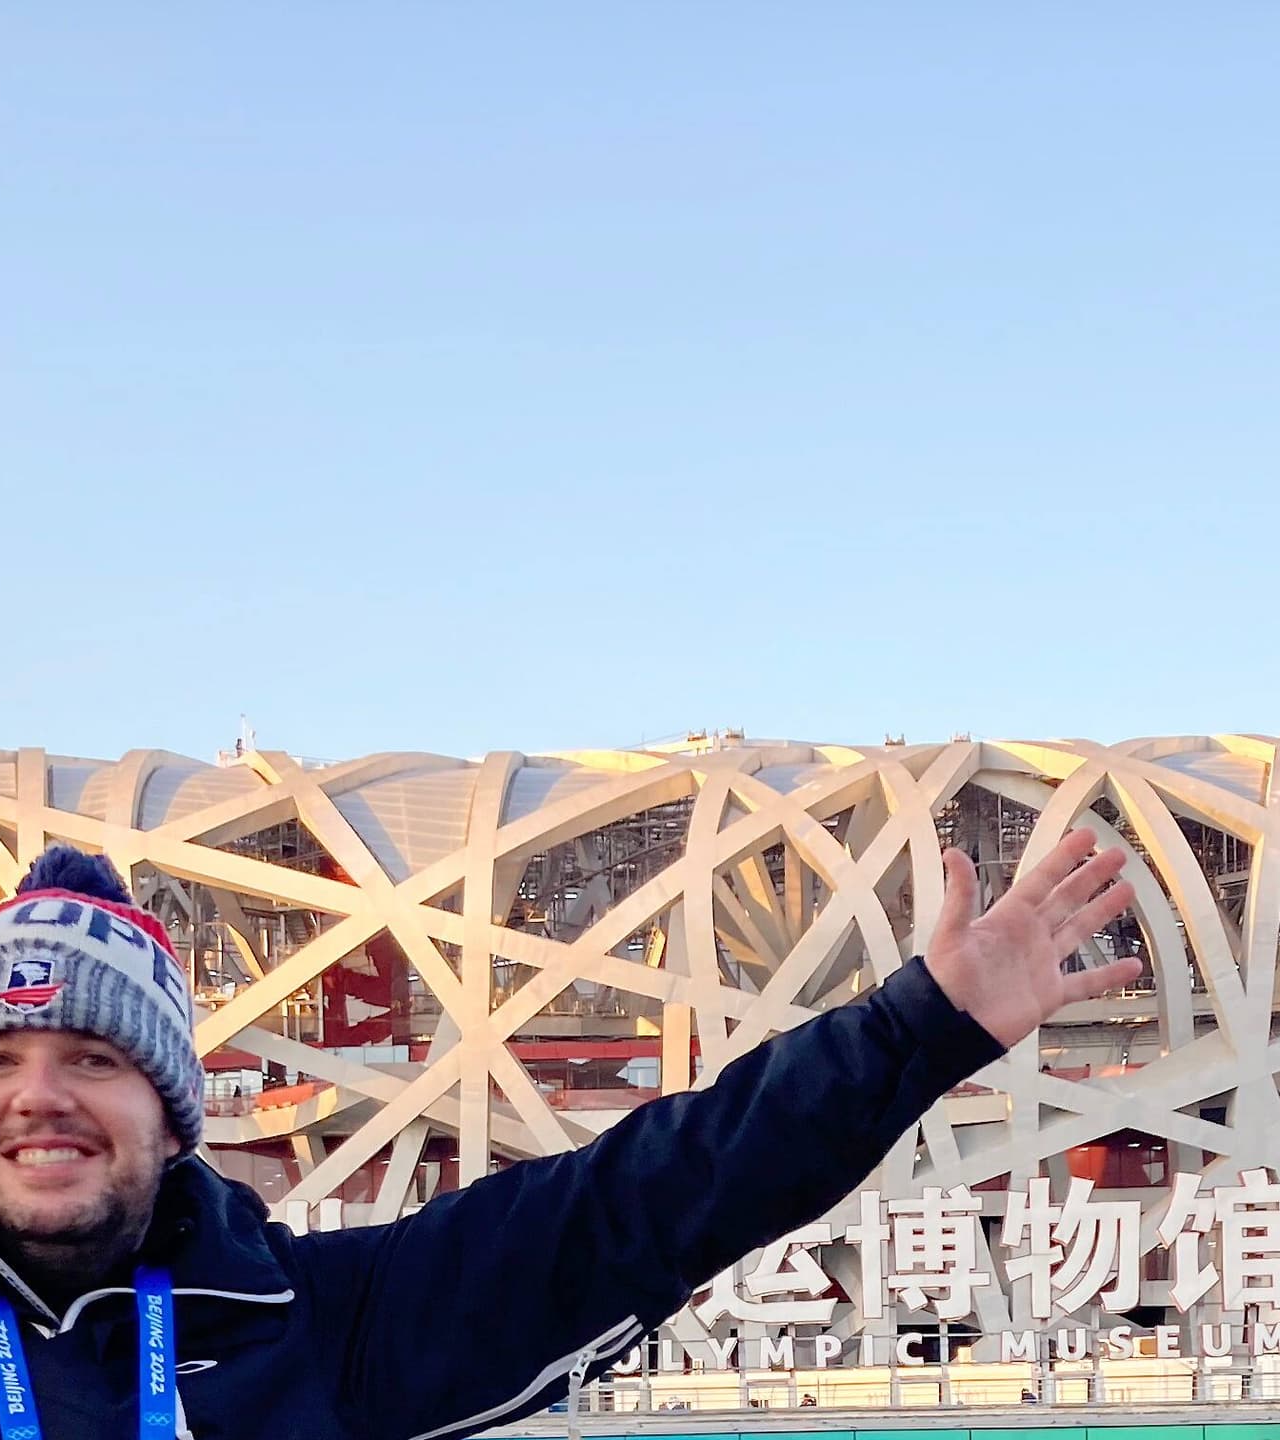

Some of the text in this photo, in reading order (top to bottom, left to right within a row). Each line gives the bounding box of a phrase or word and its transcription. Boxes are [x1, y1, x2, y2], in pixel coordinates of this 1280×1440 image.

[146, 1294, 166, 1396] BEIJING 2022
[0, 1362, 25, 1416] BEIJING
